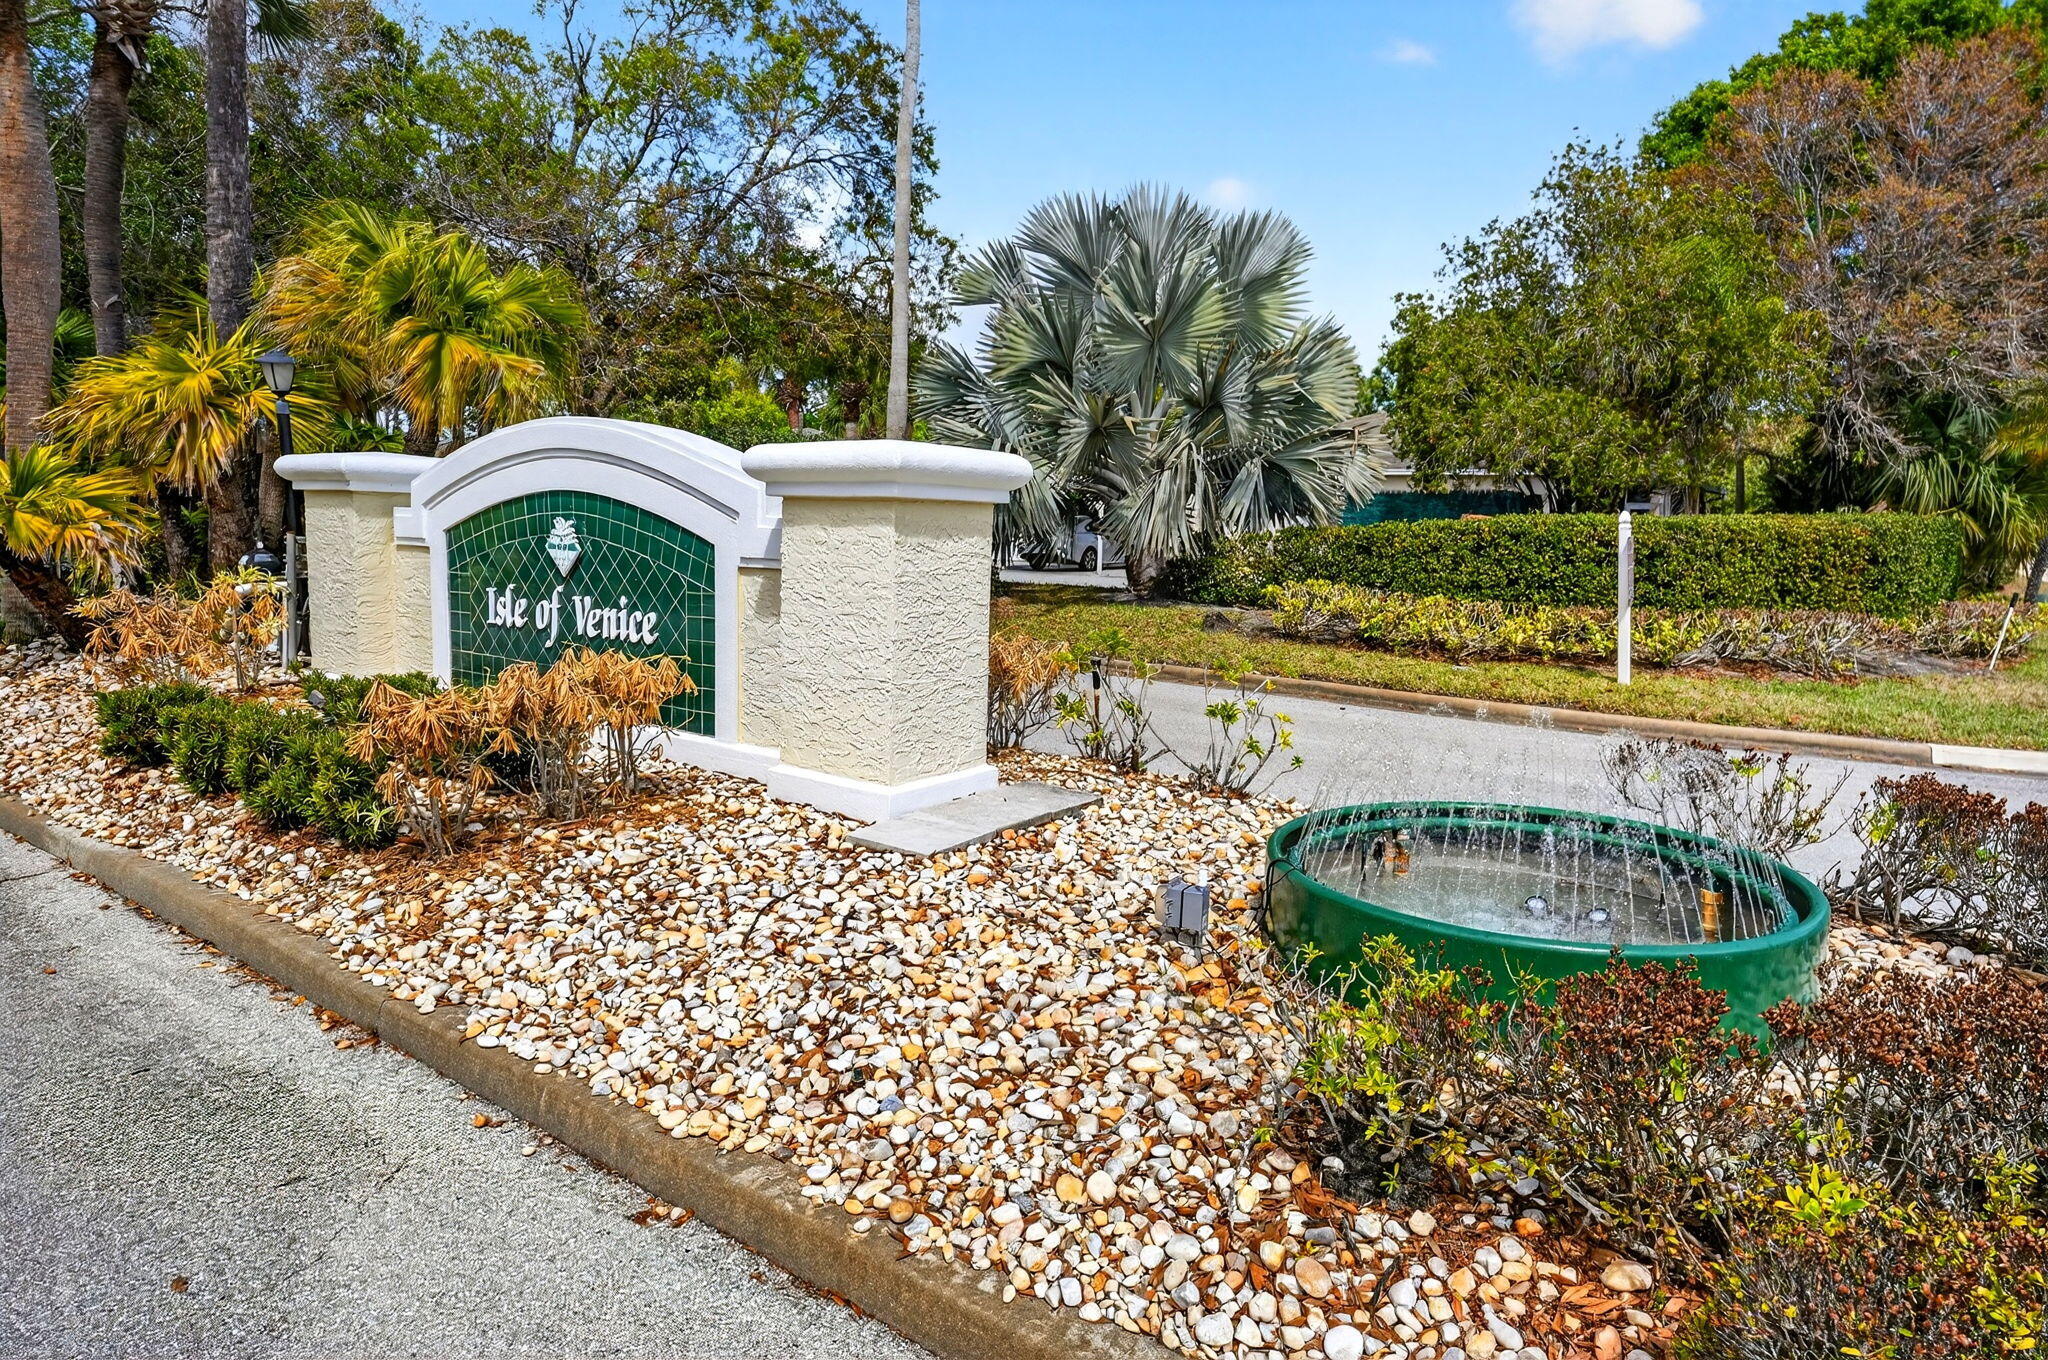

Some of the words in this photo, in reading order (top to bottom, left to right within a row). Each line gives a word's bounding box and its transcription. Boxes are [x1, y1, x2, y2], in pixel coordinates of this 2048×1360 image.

[486, 583, 529, 628] Isle
[535, 584, 565, 648] of
[572, 595, 660, 645] Venice
